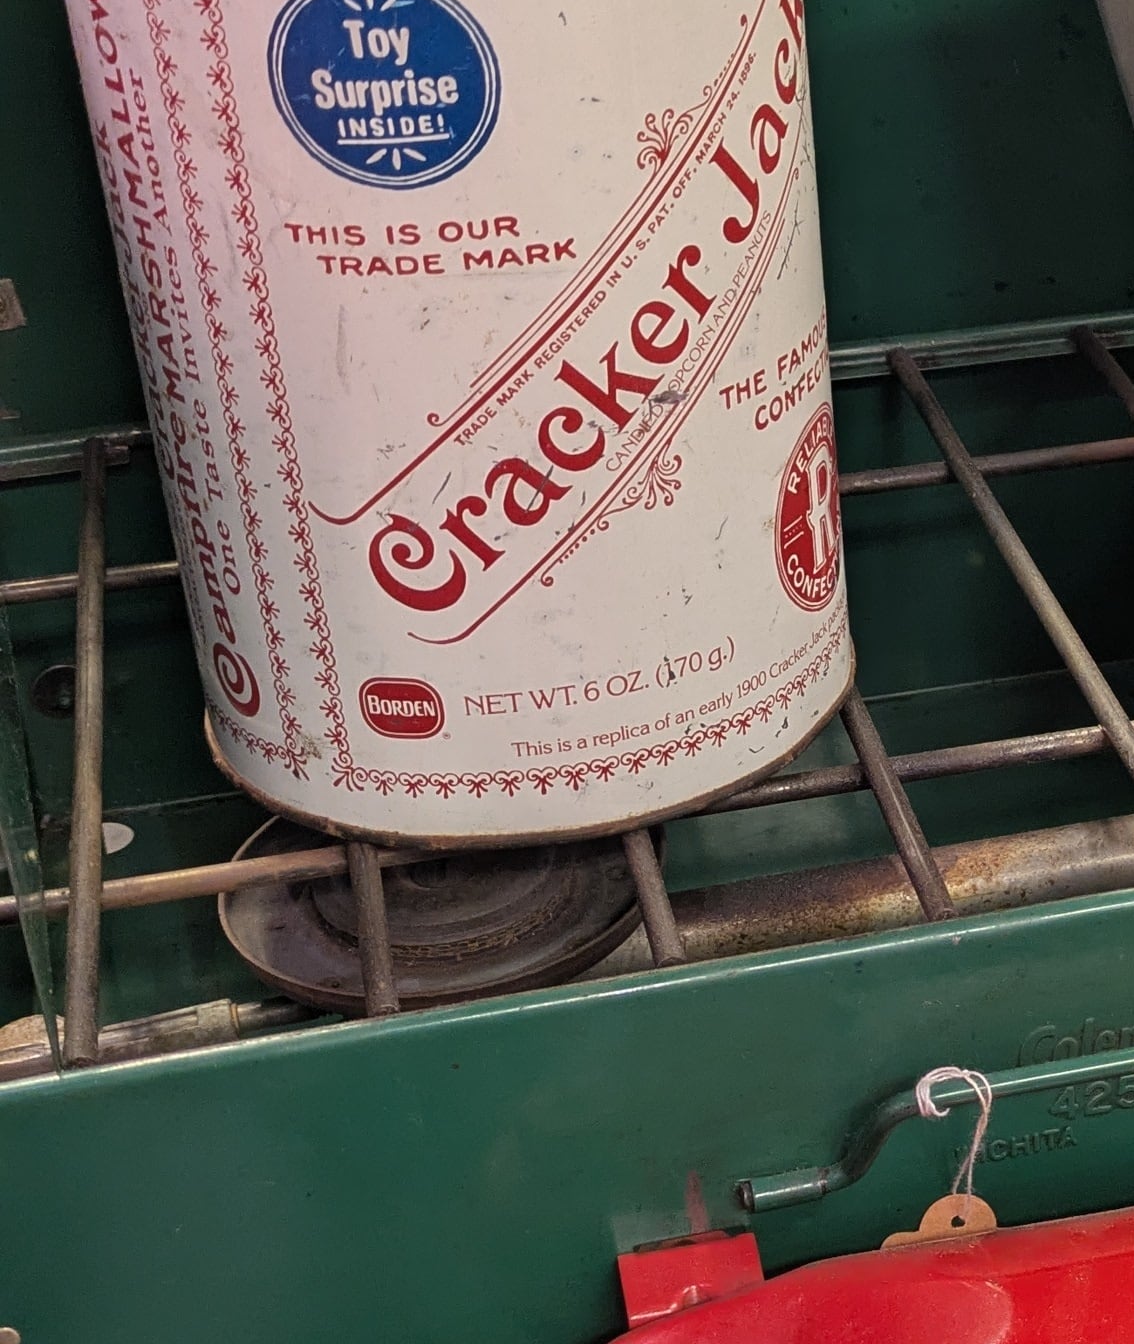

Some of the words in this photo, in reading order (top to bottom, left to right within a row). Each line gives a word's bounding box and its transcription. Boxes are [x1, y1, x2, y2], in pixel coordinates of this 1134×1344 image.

[343, 19, 410, 65] Toy
[311, 69, 459, 116] Surprise
[337, 113, 446, 138] INSIDE!
[129, 67, 173, 237] Another
[284, 222, 366, 246] THIS
[386, 223, 421, 245] IS
[438, 216, 520, 244] OUR
[317, 253, 445, 276] TRADE
[463, 238, 577, 270] MARK
[164, 244, 201, 384] Invites
[454, 406, 498, 447] TRADE
[496, 369, 535, 407] MARK
[533, 289, 607, 370] REGISTERED
[606, 270, 622, 289] IN
[647, 202, 676, 235] PAT.
[672, 166, 698, 199] OFF.
[695, 112, 727, 165] MARCH
[605, 402, 665, 472] CANDIED
[655, 324, 714, 402] OPCORN
[713, 288, 736, 326] AND
[732, 209, 773, 292] PEANUTS
[369, 243, 718, 612] Cracker
[719, 369, 768, 410] THE
[193, 398, 226, 502] Taste
[171, 412, 262, 719] Campfire
[217, 518, 241, 596] One
[366, 694, 436, 717] BORDEN
[464, 692, 523, 716] NET
[528, 684, 577, 710] WT.
[583, 680, 600, 702] 6
[606, 670, 650, 698] OZ.
[511, 739, 553, 757] This
[557, 737, 572, 753] is
[577, 737, 588, 750] a
[593, 724, 650, 748] replica
[655, 712, 671, 731] of
[675, 708, 696, 725] an
[699, 691, 734, 716] early
[737, 670, 767, 699] 1900
[769, 642, 809, 678] Cracker
[809, 622, 829, 649] Jack
